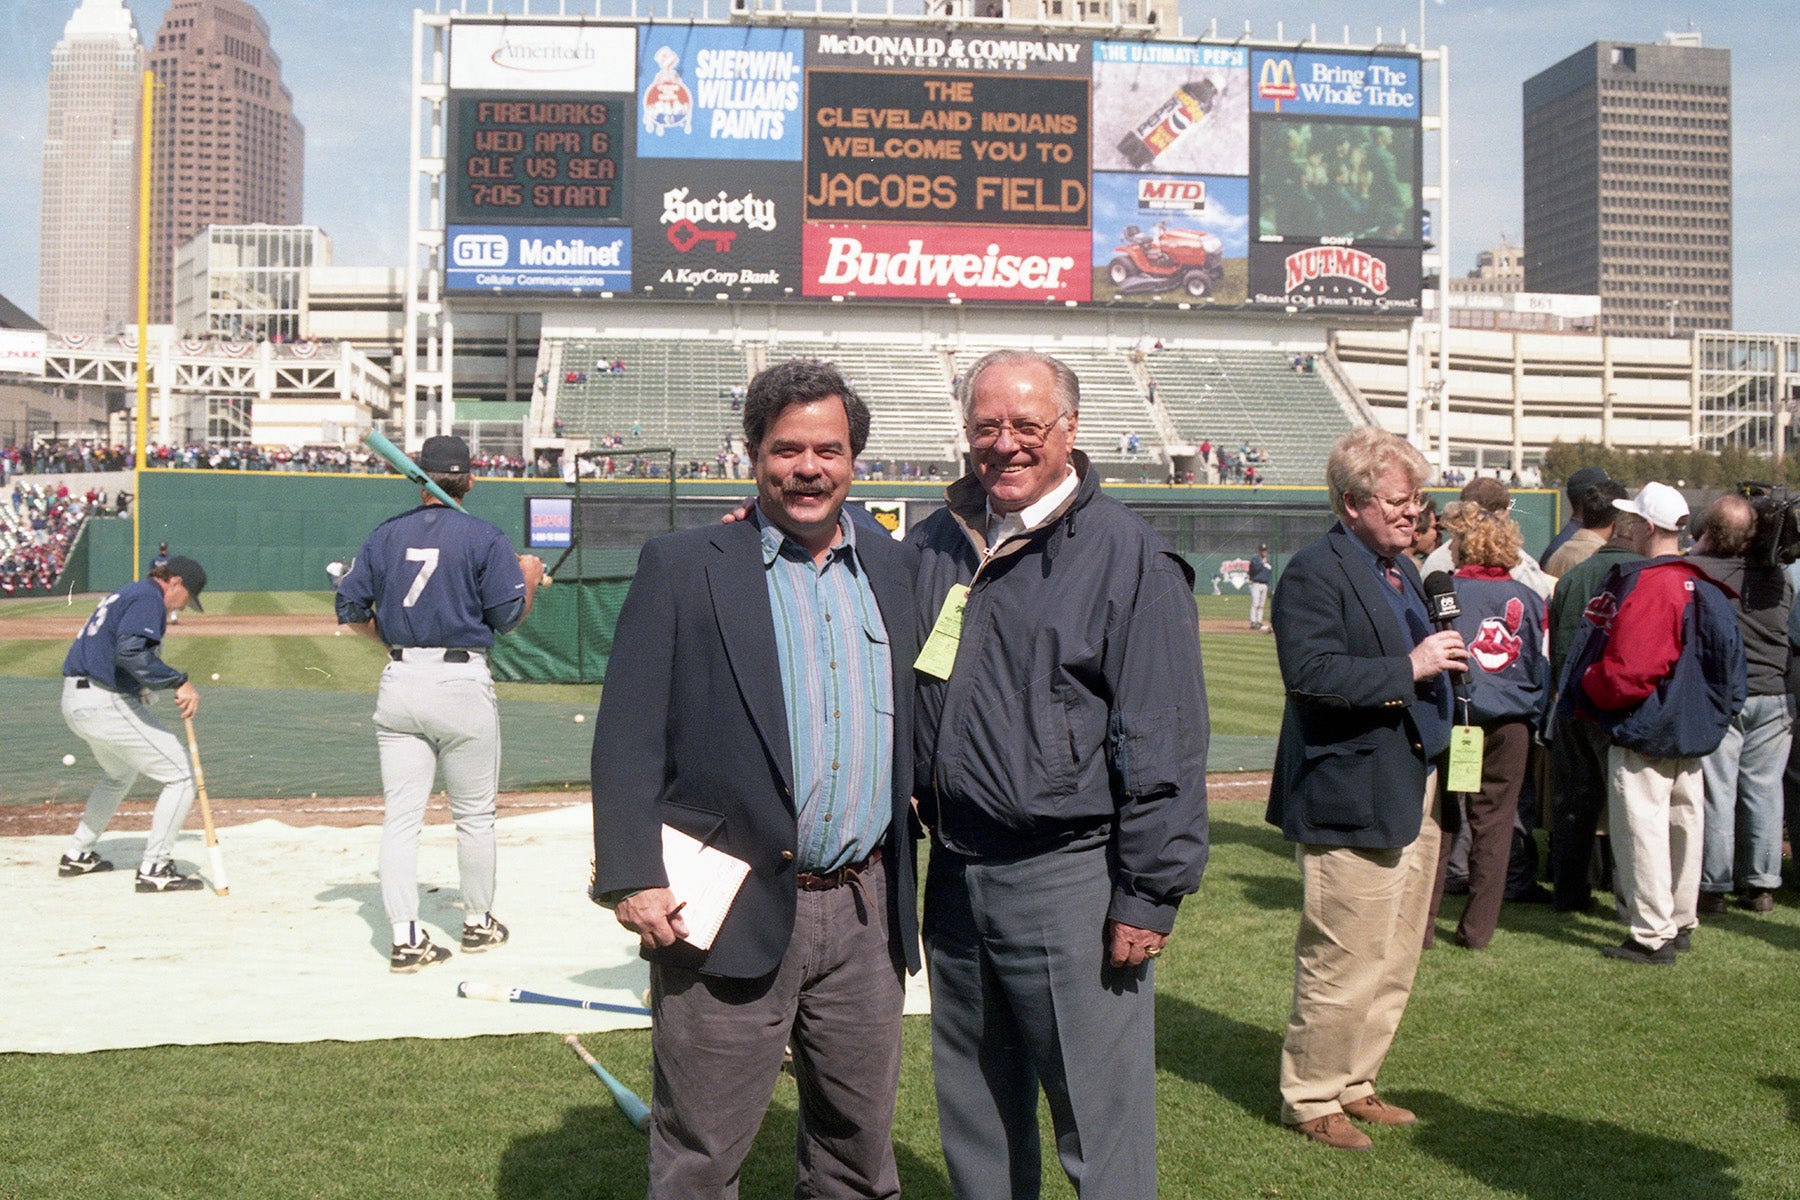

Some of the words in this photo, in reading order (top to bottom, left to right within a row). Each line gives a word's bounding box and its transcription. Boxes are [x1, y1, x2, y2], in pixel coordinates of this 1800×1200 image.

[495, 40, 596, 60] Ameritech
[818, 34, 945, 58] McDONALD
[948, 39, 965, 58] &
[968, 39, 1081, 63] COMPANY
[1100, 44, 1128, 62] THE
[1131, 46, 1199, 64] ULTIMATE
[1203, 48, 1243, 66] PEPSI
[695, 49, 800, 80] SHERWIN-
[873, 55, 1028, 71] INVESTMENTS
[1312, 63, 1365, 88] Bring
[1368, 65, 1407, 87] The
[697, 79, 799, 111] WILLIAMS
[924, 80, 974, 103] THE
[1300, 83, 1363, 106] Whole
[1364, 86, 1415, 108] Tribe
[477, 102, 607, 125] FIREWORKS
[710, 109, 785, 141] PAINTS
[816, 107, 972, 132] CLEVELAND
[981, 112, 1077, 135] INDIANS
[474, 130, 524, 152] WED
[534, 131, 581, 153] APR
[591, 131, 609, 154] 6
[822, 136, 963, 160] WELCOME
[971, 140, 1027, 163] YOU
[1036, 142, 1073, 163] TO
[467, 156, 514, 179] CLE
[524, 157, 558, 180] VS
[568, 158, 616, 181] SEA
[469, 184, 524, 207] 7:05
[533, 185, 612, 208] START
[807, 172, 958, 210] JACOBS
[976, 176, 1087, 214] FIELD
[1142, 182, 1202, 200] MTD
[660, 187, 777, 231] Society
[458, 240, 504, 260] GTE
[519, 238, 621, 267] Mobilnet
[818, 237, 1075, 289] Budweiser
[476, 274, 515, 286] Cellular
[516, 274, 605, 287] Communications
[660, 269, 674, 283] A
[676, 268, 739, 287] KeyCorp
[739, 269, 780, 284] Bank
[1285, 246, 1388, 296] NUTMEG
[1255, 293, 1290, 304] Stand
[1291, 294, 1314, 305] Out
[1317, 295, 1349, 306] From
[1351, 296, 1374, 307] The
[402, 547, 440, 608] 7
